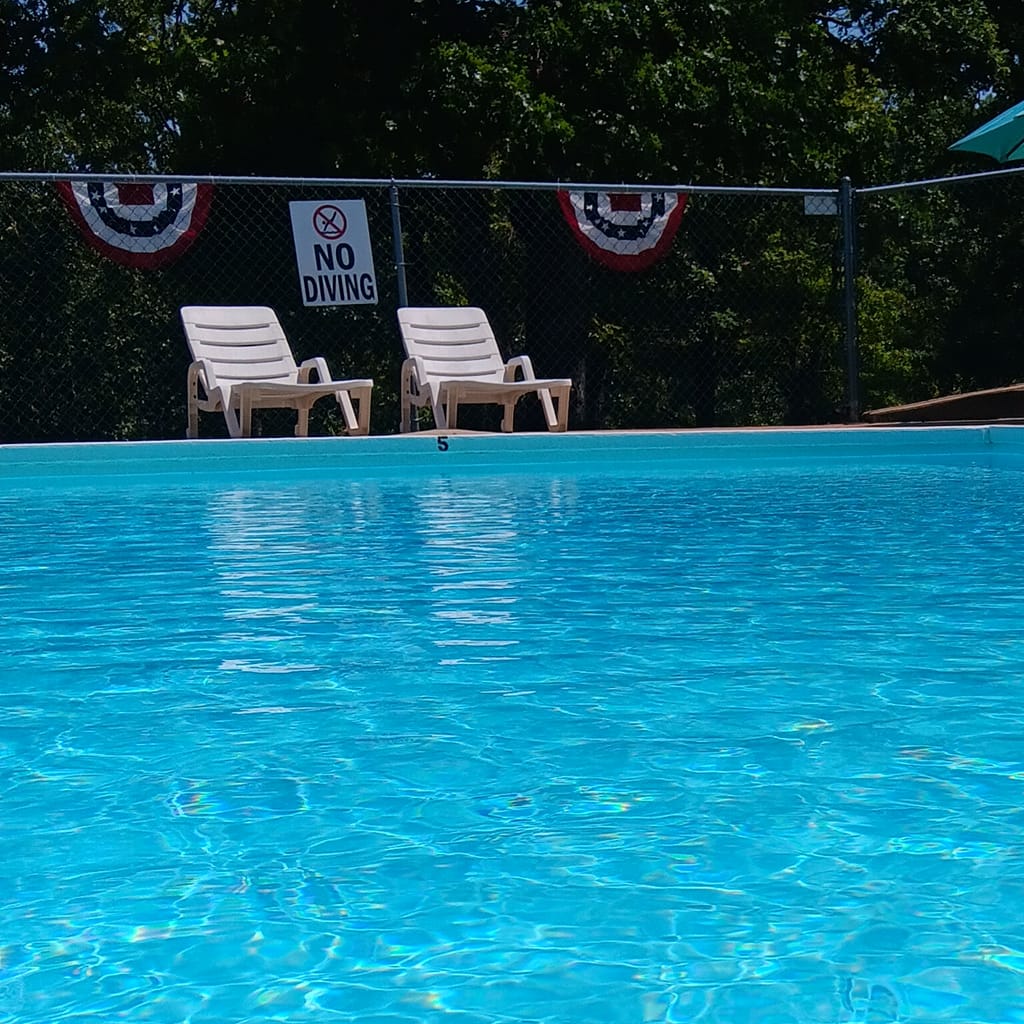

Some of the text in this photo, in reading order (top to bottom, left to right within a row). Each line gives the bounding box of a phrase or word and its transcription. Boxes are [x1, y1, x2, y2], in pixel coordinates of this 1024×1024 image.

[314, 243, 355, 271] NO
[303, 273, 375, 302] DIVING
[437, 436, 449, 451] 5
